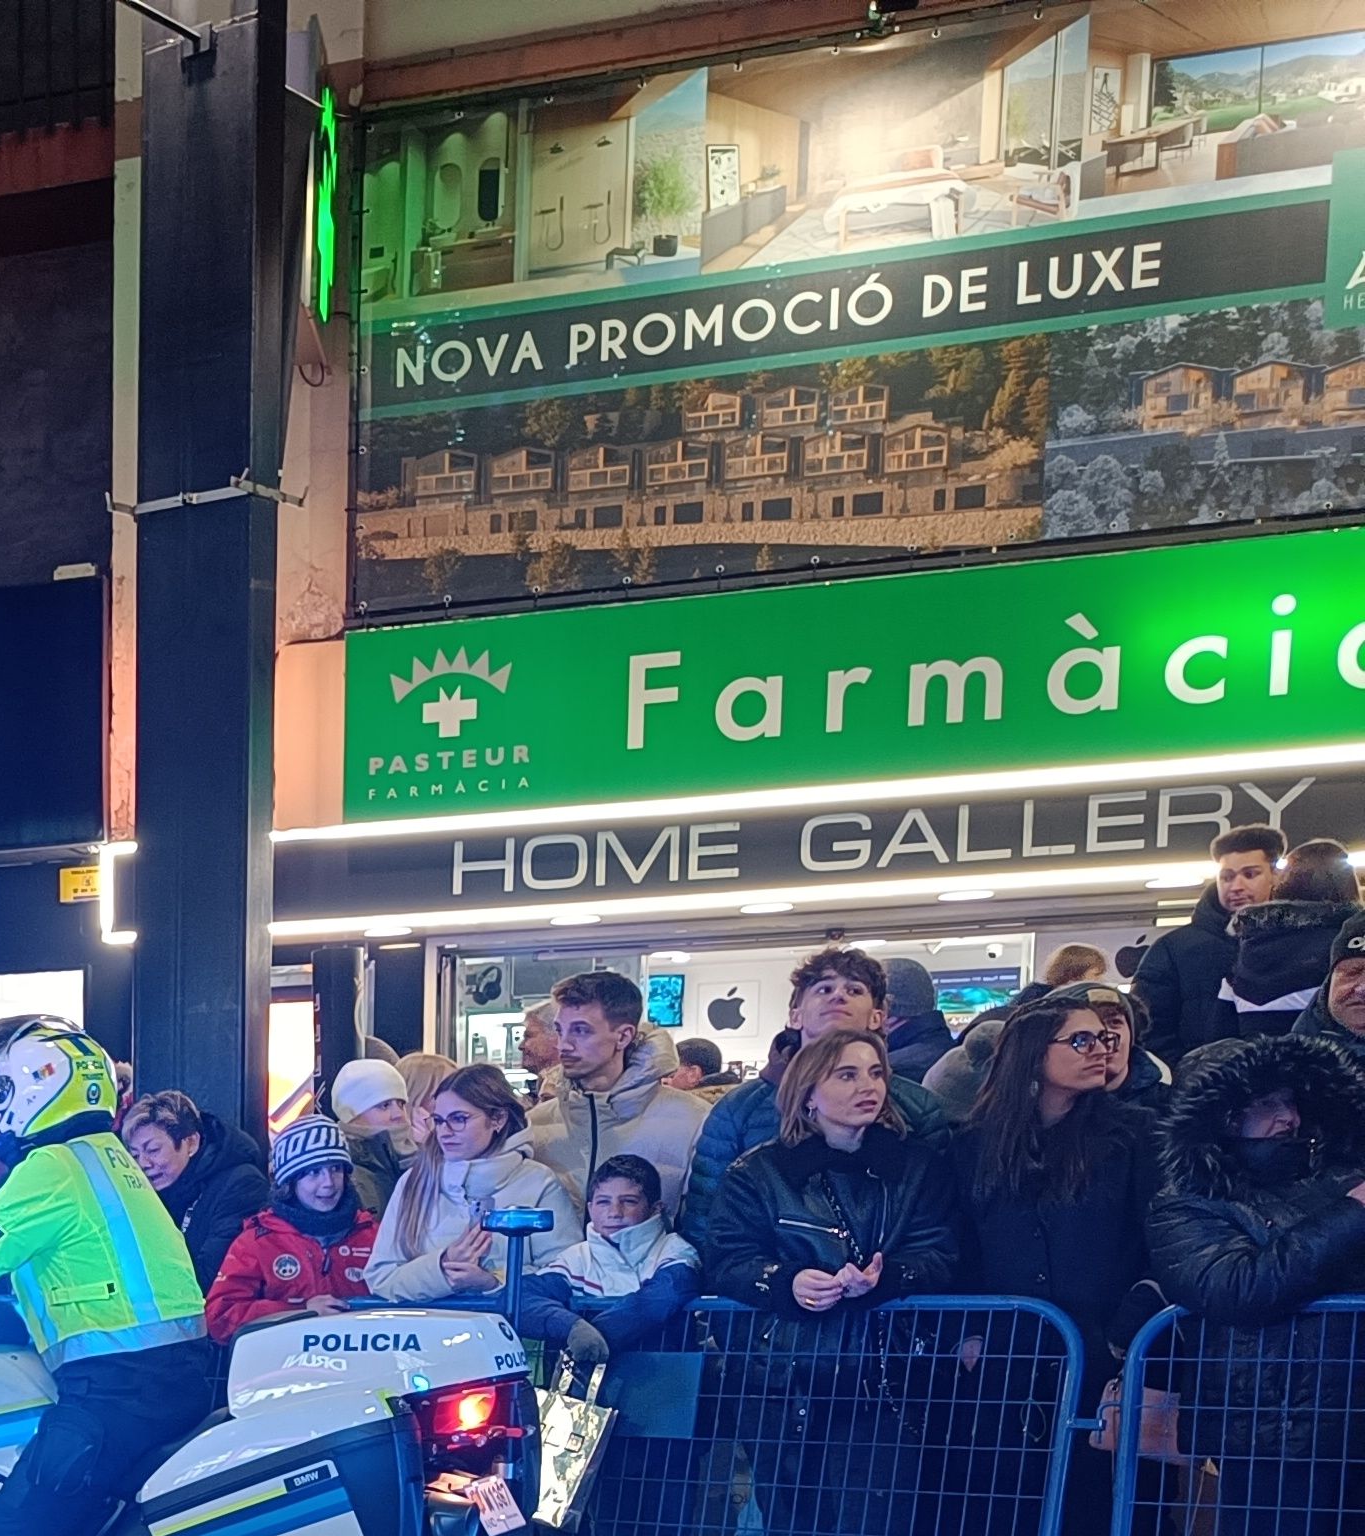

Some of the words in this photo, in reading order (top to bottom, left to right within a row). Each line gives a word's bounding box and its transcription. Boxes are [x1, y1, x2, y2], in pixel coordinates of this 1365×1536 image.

[396, 330, 544, 388] NOVA
[569, 271, 893, 366] PROMOCIÓ
[922, 266, 988, 319] DE
[1016, 241, 1162, 306] LUXE
[368, 745, 530, 776] PASTEUR
[368, 777, 529, 800] FARMÀCIA
[452, 820, 741, 895] HOME
[799, 777, 1317, 872] GALLERY
[303, 1333, 422, 1353] POLICIA
[293, 1470, 319, 1487] BMW
